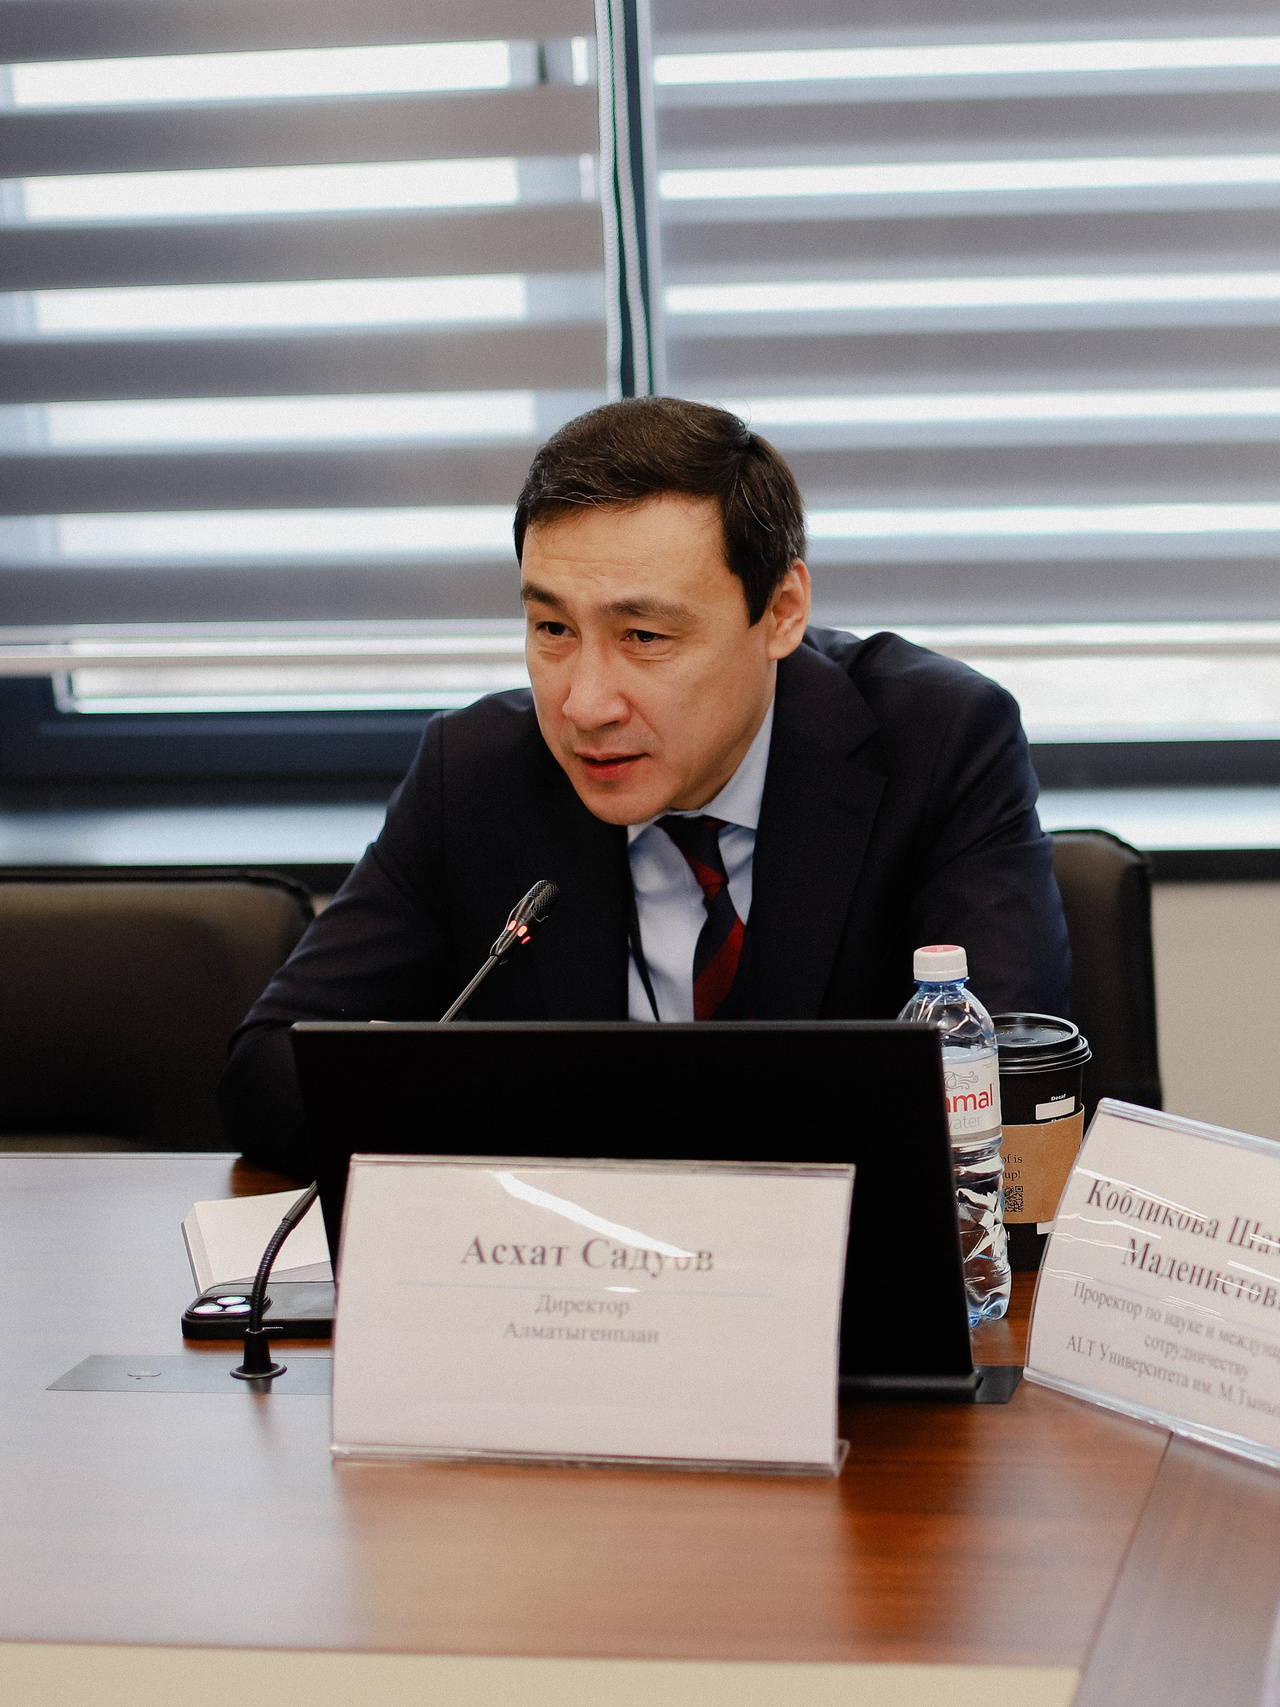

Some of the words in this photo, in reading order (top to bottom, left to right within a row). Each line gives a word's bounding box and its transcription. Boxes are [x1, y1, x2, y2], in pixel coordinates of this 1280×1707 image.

[945, 1083, 994, 1113] mal
[1050, 1093, 1067, 1101] Decaf
[949, 1116, 983, 1130] ater
[1014, 1154, 1023, 1164] is
[461, 1234, 570, 1267] Асхат
[581, 1238, 714, 1279] Садуов
[535, 1294, 631, 1319] Директор
[1073, 1280, 1143, 1321] Проректор
[1145, 1306, 1162, 1322] по
[502, 1321, 660, 1344] Алматыгенплан
[1066, 1334, 1096, 1357] ALT
[1100, 1343, 1190, 1389] Университета
